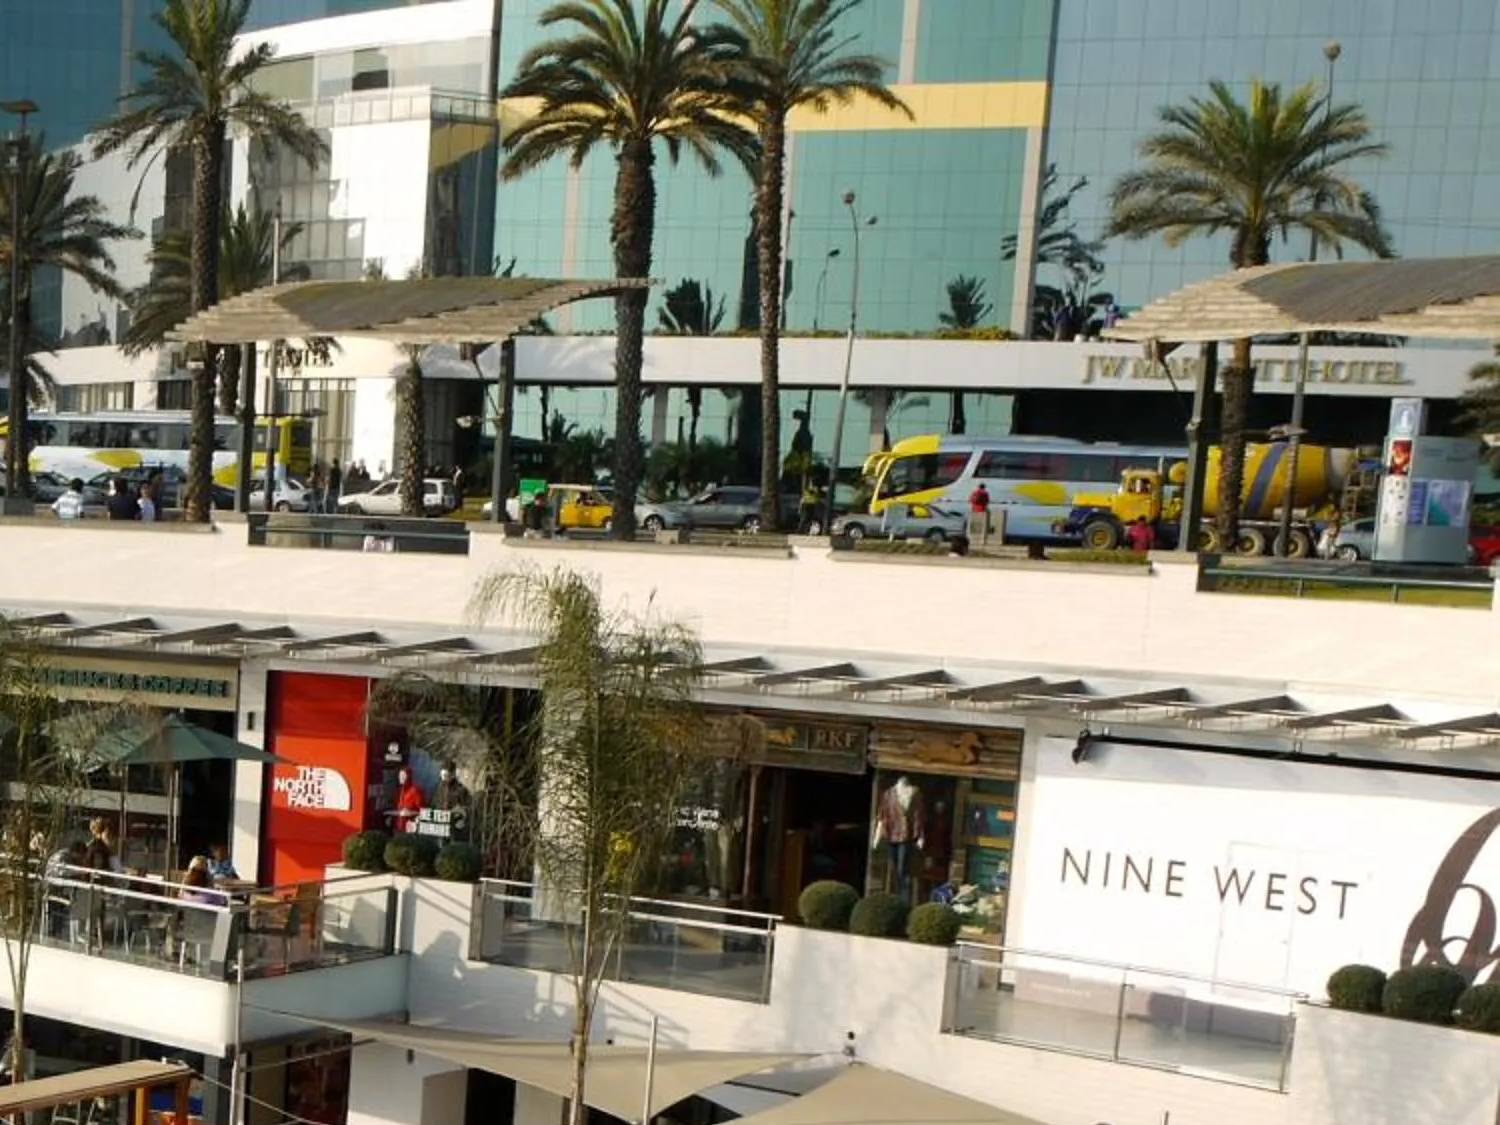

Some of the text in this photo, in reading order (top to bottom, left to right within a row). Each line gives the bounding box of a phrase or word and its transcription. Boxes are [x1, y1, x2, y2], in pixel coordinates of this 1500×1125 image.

[1082, 355, 1415, 386] JW MARTT HOTEL
[24, 666, 140, 692] ARBUCKS
[296, 765, 325, 780] THE
[274, 777, 325, 796] NORTH
[287, 792, 326, 809] FACE
[1060, 847, 1360, 920] NINE WEST
